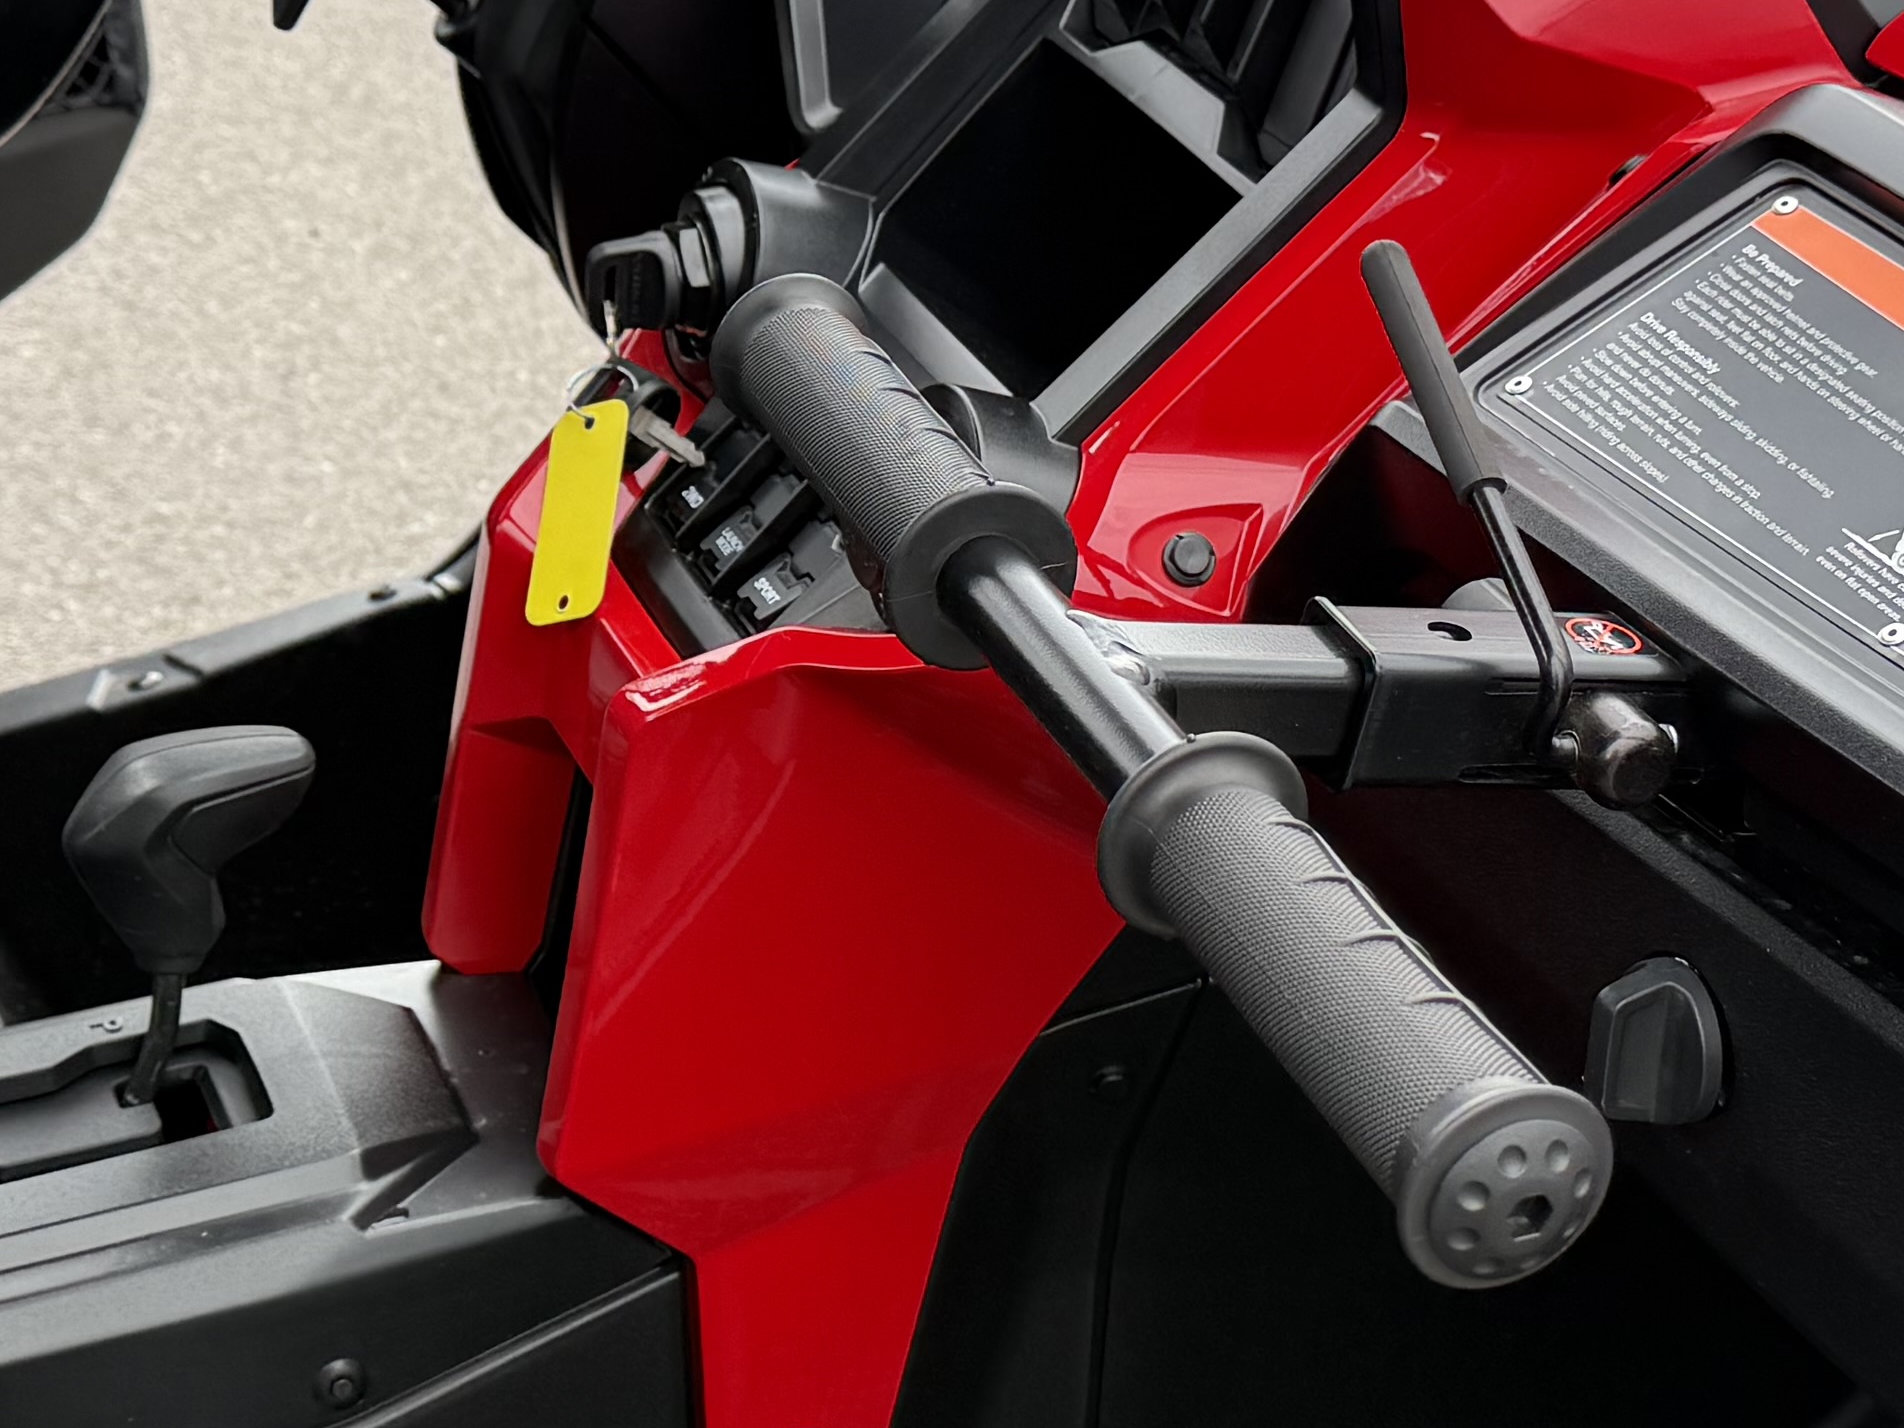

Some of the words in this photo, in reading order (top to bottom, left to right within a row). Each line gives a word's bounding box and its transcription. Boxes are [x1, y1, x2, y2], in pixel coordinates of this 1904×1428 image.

[1740, 242, 1759, 258] Be
[1754, 253, 1803, 286] Prepared
[1639, 311, 1666, 333] Drive
[1662, 329, 1720, 374] Responsibly
[753, 577, 781, 604] SPORT
[89, 1015, 123, 1034] P
